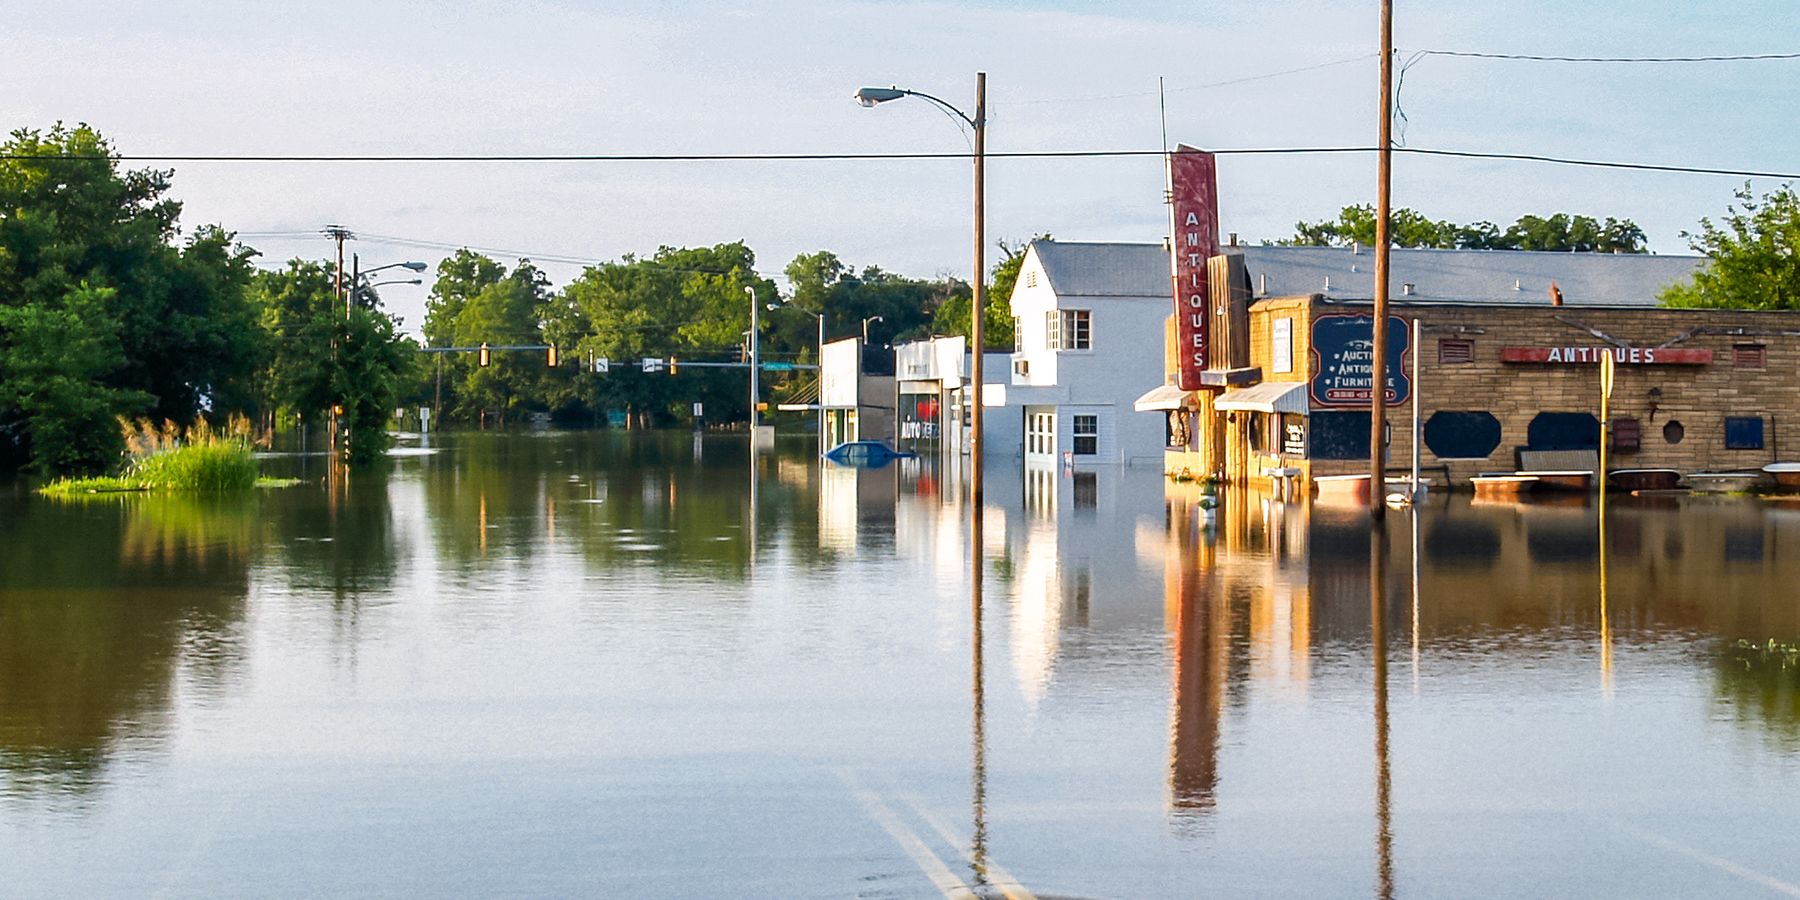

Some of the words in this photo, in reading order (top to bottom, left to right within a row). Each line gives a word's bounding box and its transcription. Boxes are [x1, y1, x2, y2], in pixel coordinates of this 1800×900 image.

[1185, 212, 1203, 366] ANTIQUES
[1334, 376, 1396, 389] FURNITE
[902, 421, 921, 439] AUTO
